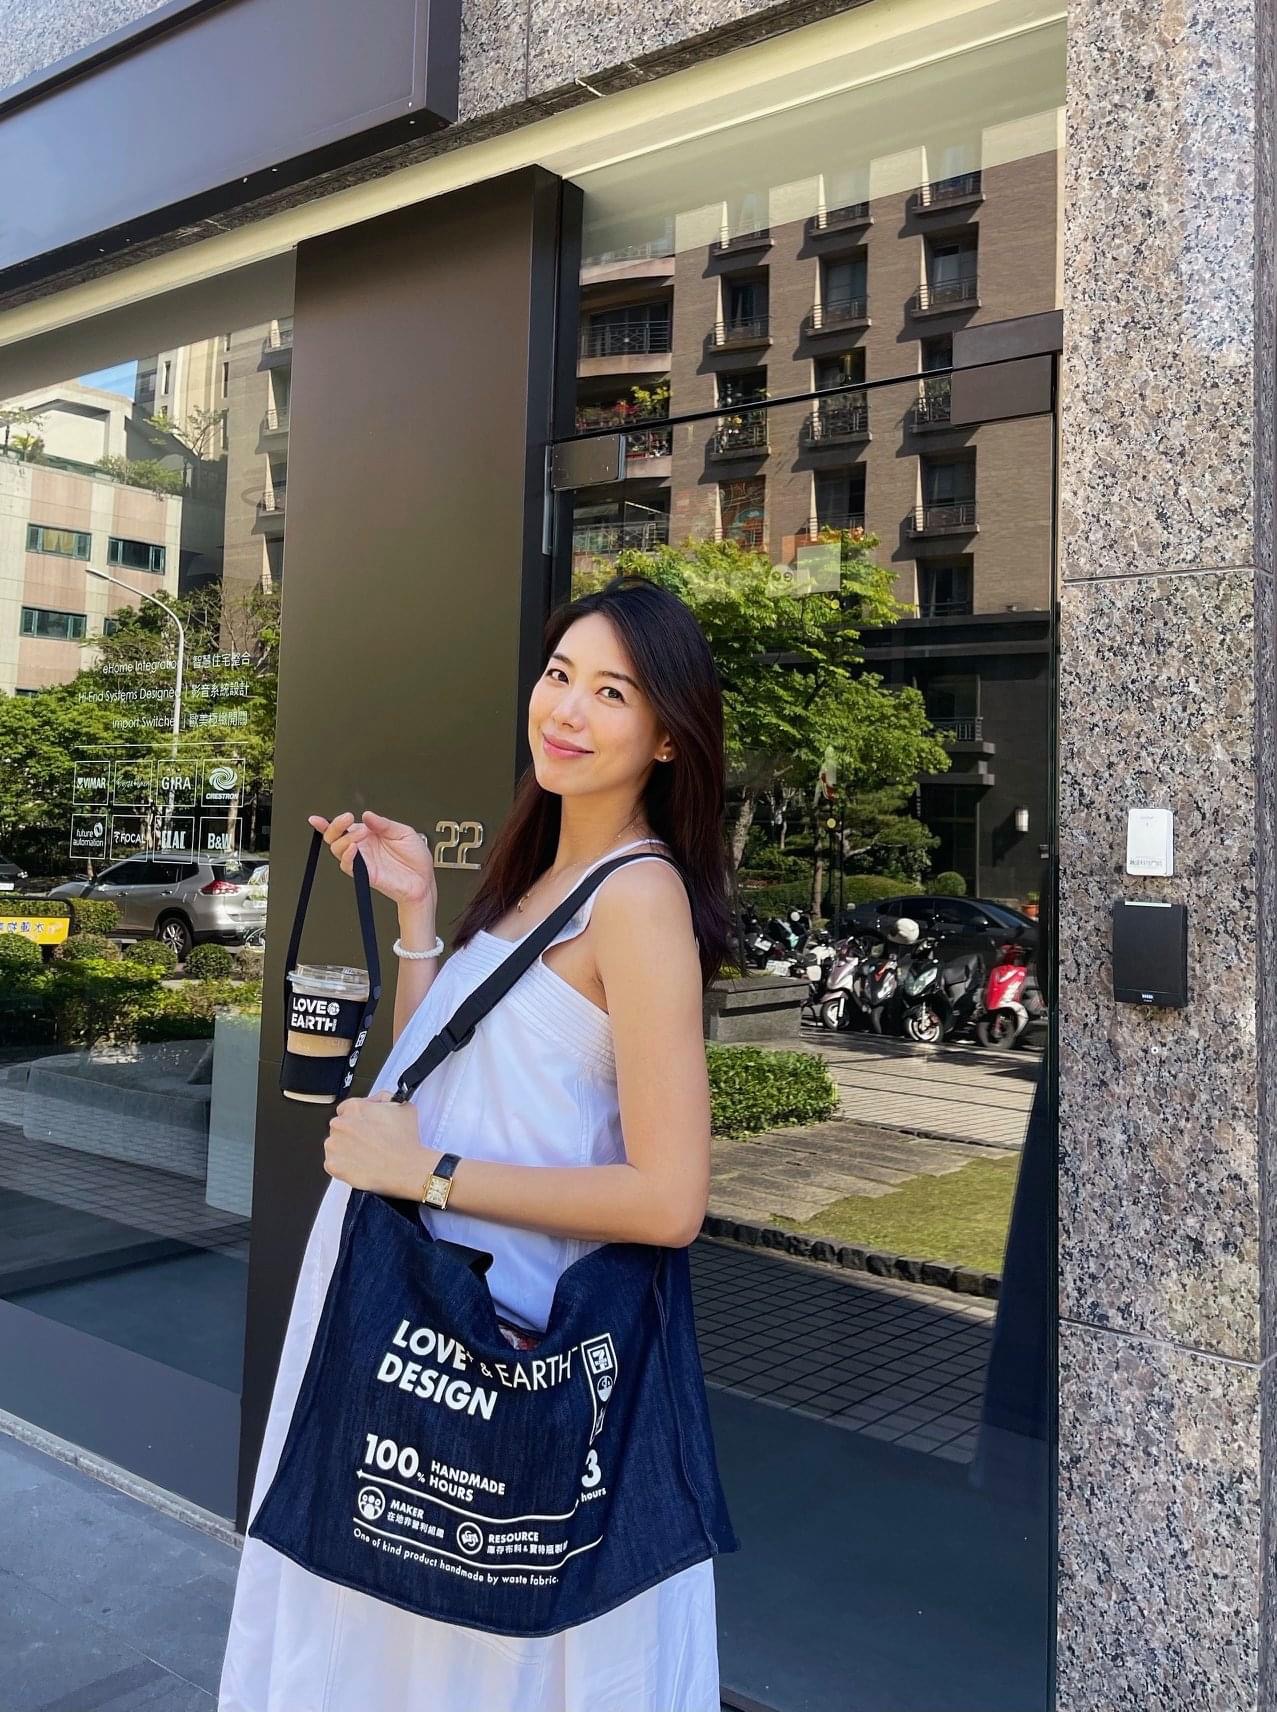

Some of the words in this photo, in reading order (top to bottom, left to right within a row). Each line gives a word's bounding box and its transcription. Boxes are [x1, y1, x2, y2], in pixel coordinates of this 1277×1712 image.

[102, 662, 132, 675] eHome
[135, 659, 179, 673] Integratio
[192, 651, 251, 669] 智慧住宅整合
[78, 690, 103, 703] Hi-End
[105, 689, 138, 702] Systems
[191, 681, 250, 699] 影音系統設計
[141, 716, 177, 728] Switche
[83, 777, 106, 789] VIMAR
[161, 776, 192, 790] GIRA
[76, 828, 94, 838] future
[120, 832, 146, 845] FOCAL
[207, 832, 232, 850] B&W
[72, 838, 104, 847] automation
[293, 997, 327, 1015] LOVE
[290, 1012, 338, 1032] EARTH
[392, 1319, 467, 1371] LOVE
[479, 1362, 493, 1378] &
[495, 1350, 571, 1391] EARTH
[376, 1352, 498, 1420] DESIGN
[581, 1449, 602, 1488] 3
[430, 1460, 506, 1496] HANDMADE
[429, 1474, 474, 1503] HOURS
[581, 1487, 607, 1503] hours
[390, 1499, 425, 1520] MAKER
[488, 1531, 540, 1544] RESOURCE
[353, 1527, 370, 1543] One
[372, 1538, 381, 1549] of
[382, 1541, 402, 1556] kind
[403, 1550, 438, 1567] product
[439, 1559, 484, 1582] handmade
[487, 1572, 499, 1586] by
[501, 1574, 528, 1585] waste
